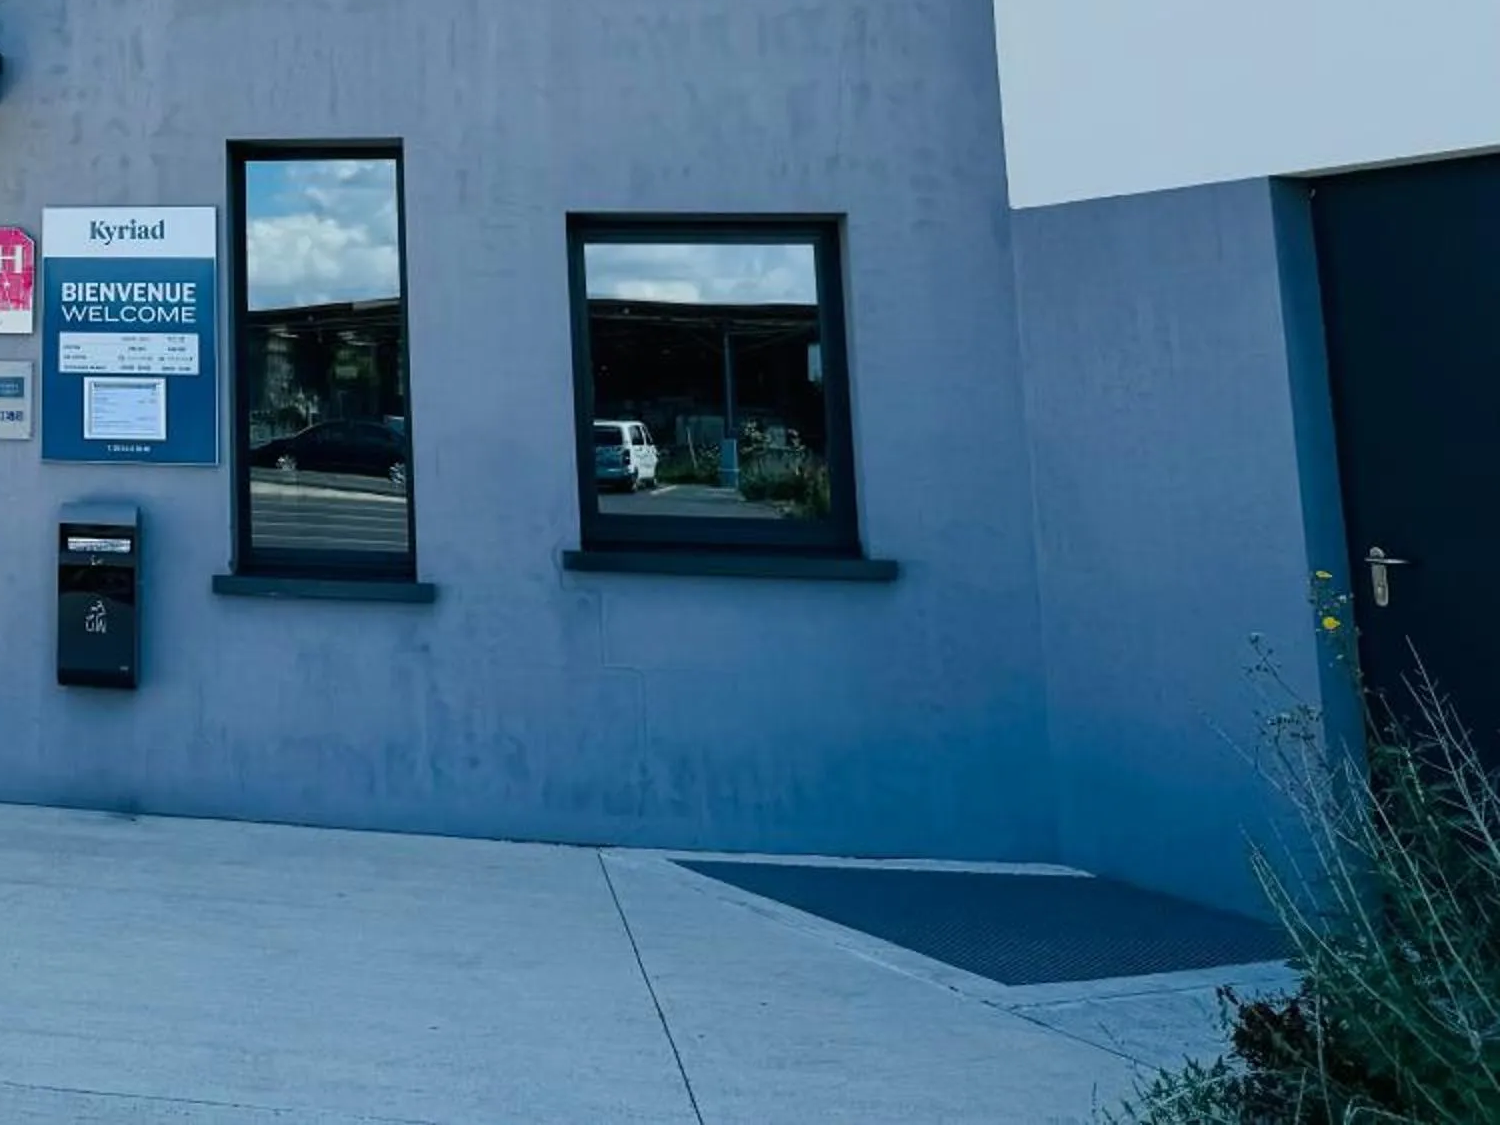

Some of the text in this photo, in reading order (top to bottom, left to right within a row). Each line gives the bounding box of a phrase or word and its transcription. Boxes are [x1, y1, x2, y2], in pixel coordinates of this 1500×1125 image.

[89, 218, 165, 246] Kyriad
[61, 282, 197, 303] BIENVENUE
[61, 305, 197, 323] WELCOME
